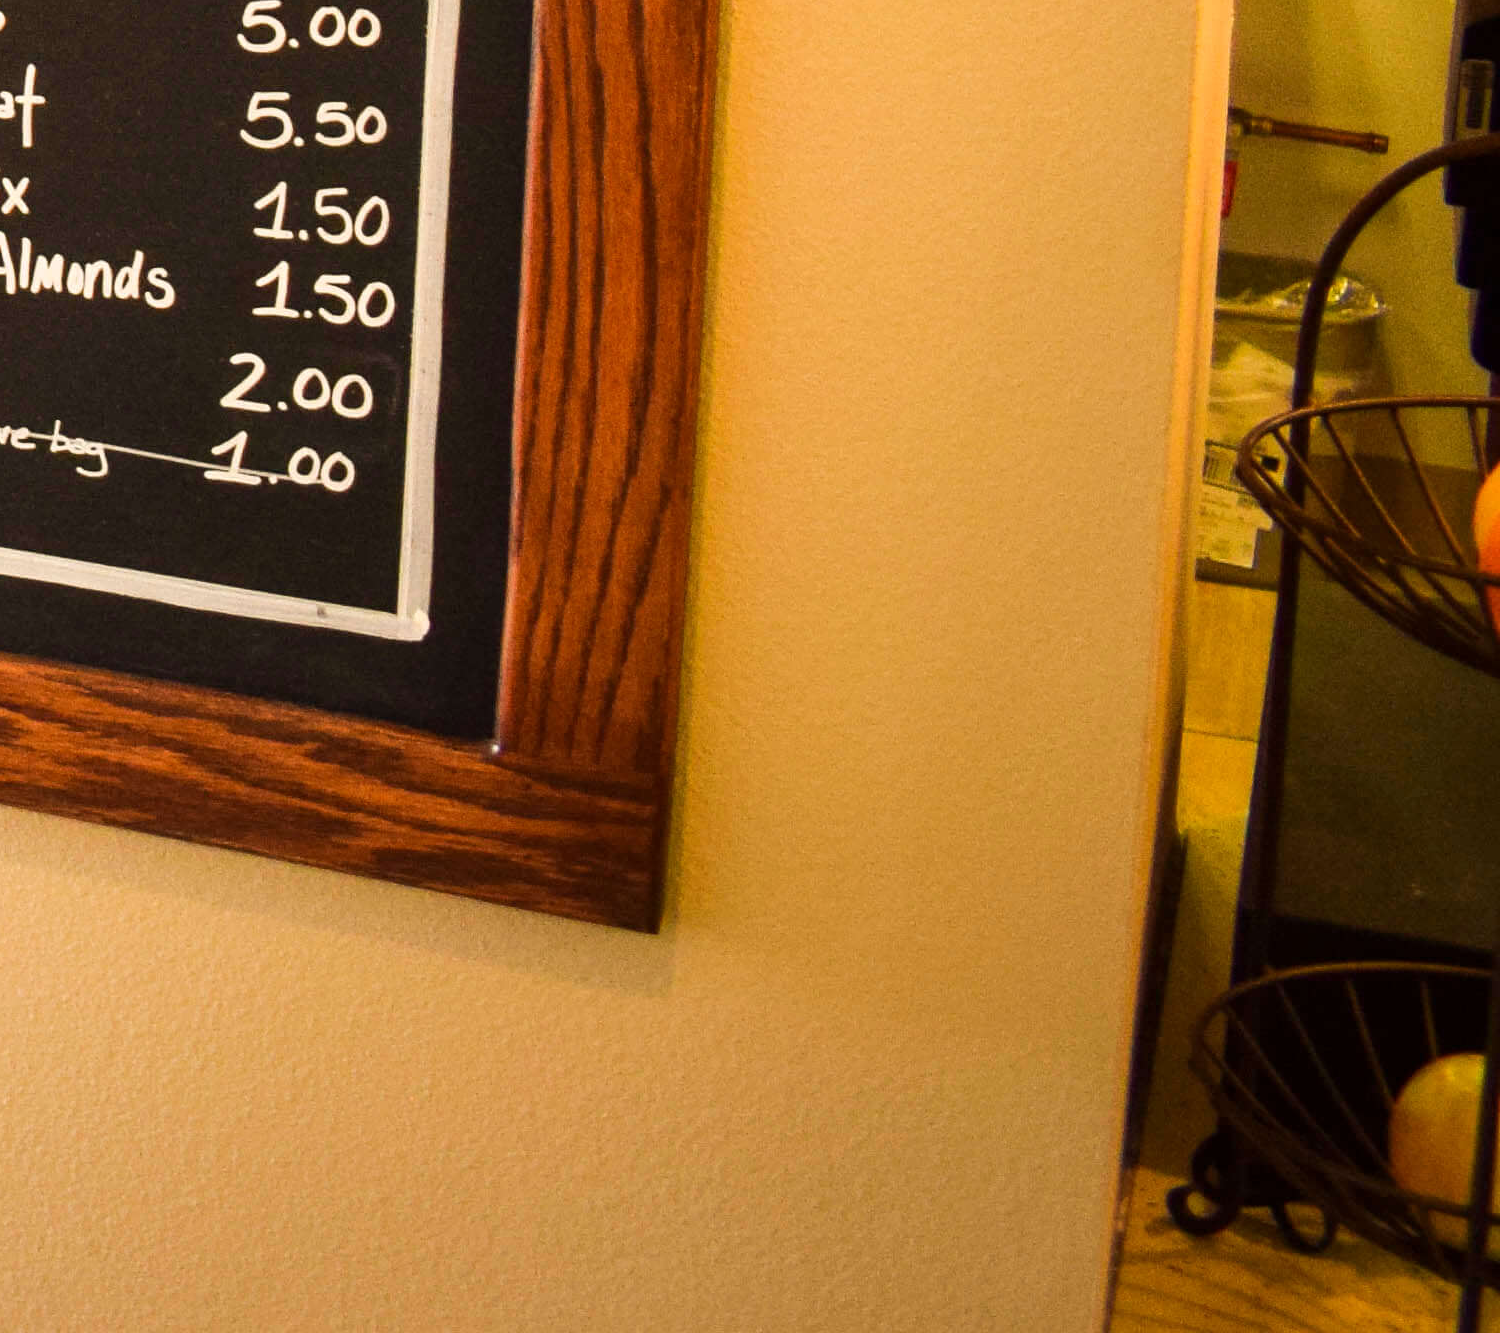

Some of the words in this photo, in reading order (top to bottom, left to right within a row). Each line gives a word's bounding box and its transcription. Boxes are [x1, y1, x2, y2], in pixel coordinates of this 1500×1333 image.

[237, 0, 380, 52] 5.00
[240, 92, 387, 148] 5.50
[254, 182, 389, 245] 1.50
[253, 261, 395, 327] 1.50
[220, 353, 372, 418] 2.00
[204, 430, 356, 493] 1.00
